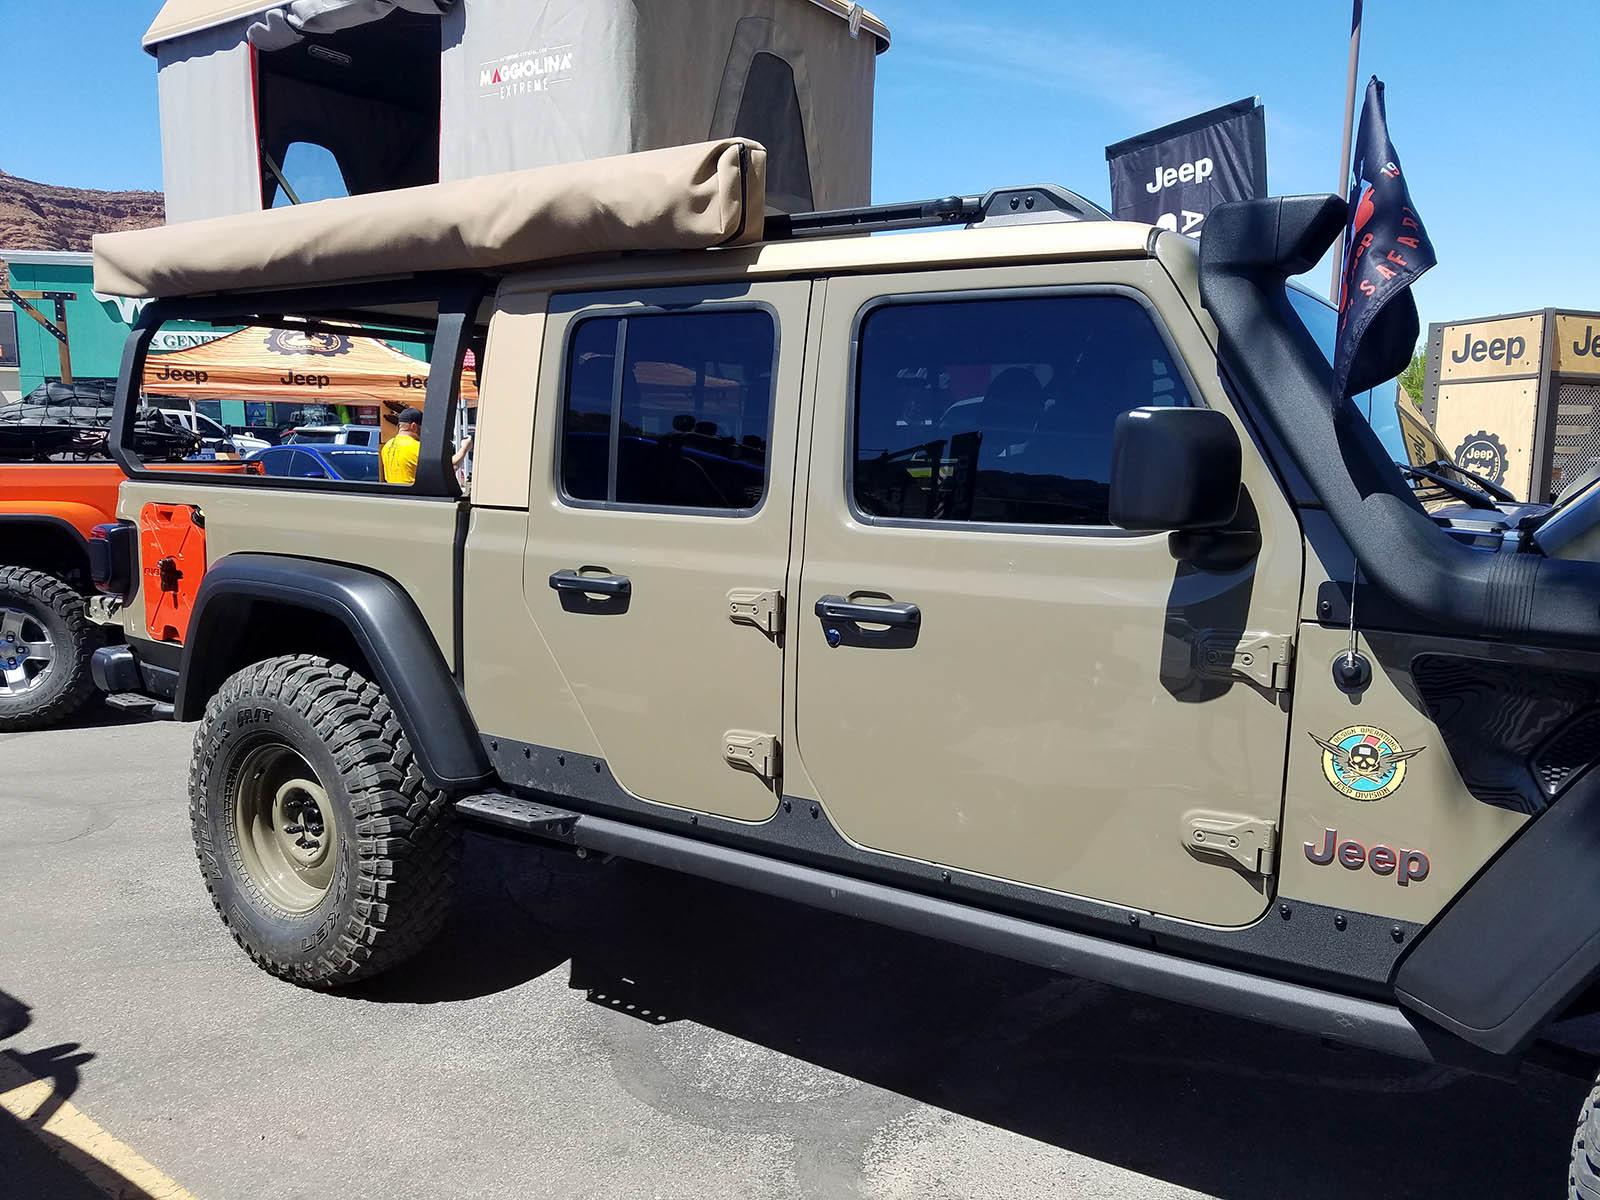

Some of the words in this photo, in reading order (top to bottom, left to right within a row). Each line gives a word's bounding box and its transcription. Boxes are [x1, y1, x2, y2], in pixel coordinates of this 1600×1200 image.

[480, 53, 572, 87] MAGGIOLINA
[500, 78, 549, 100] EXTREME
[1146, 156, 1213, 193] Jeep
[1452, 333, 1526, 366] Jeep
[156, 365, 208, 384] Jeep
[280, 369, 330, 389] Jeep
[1466, 447, 1494, 461] Jeep
[1333, 728, 1357, 744] DESIGN
[1360, 727, 1399, 751] OPERATIONS
[1333, 780, 1353, 794] JEEP
[1355, 786, 1391, 799] DIVISION
[1303, 827, 1430, 887] Jeep
